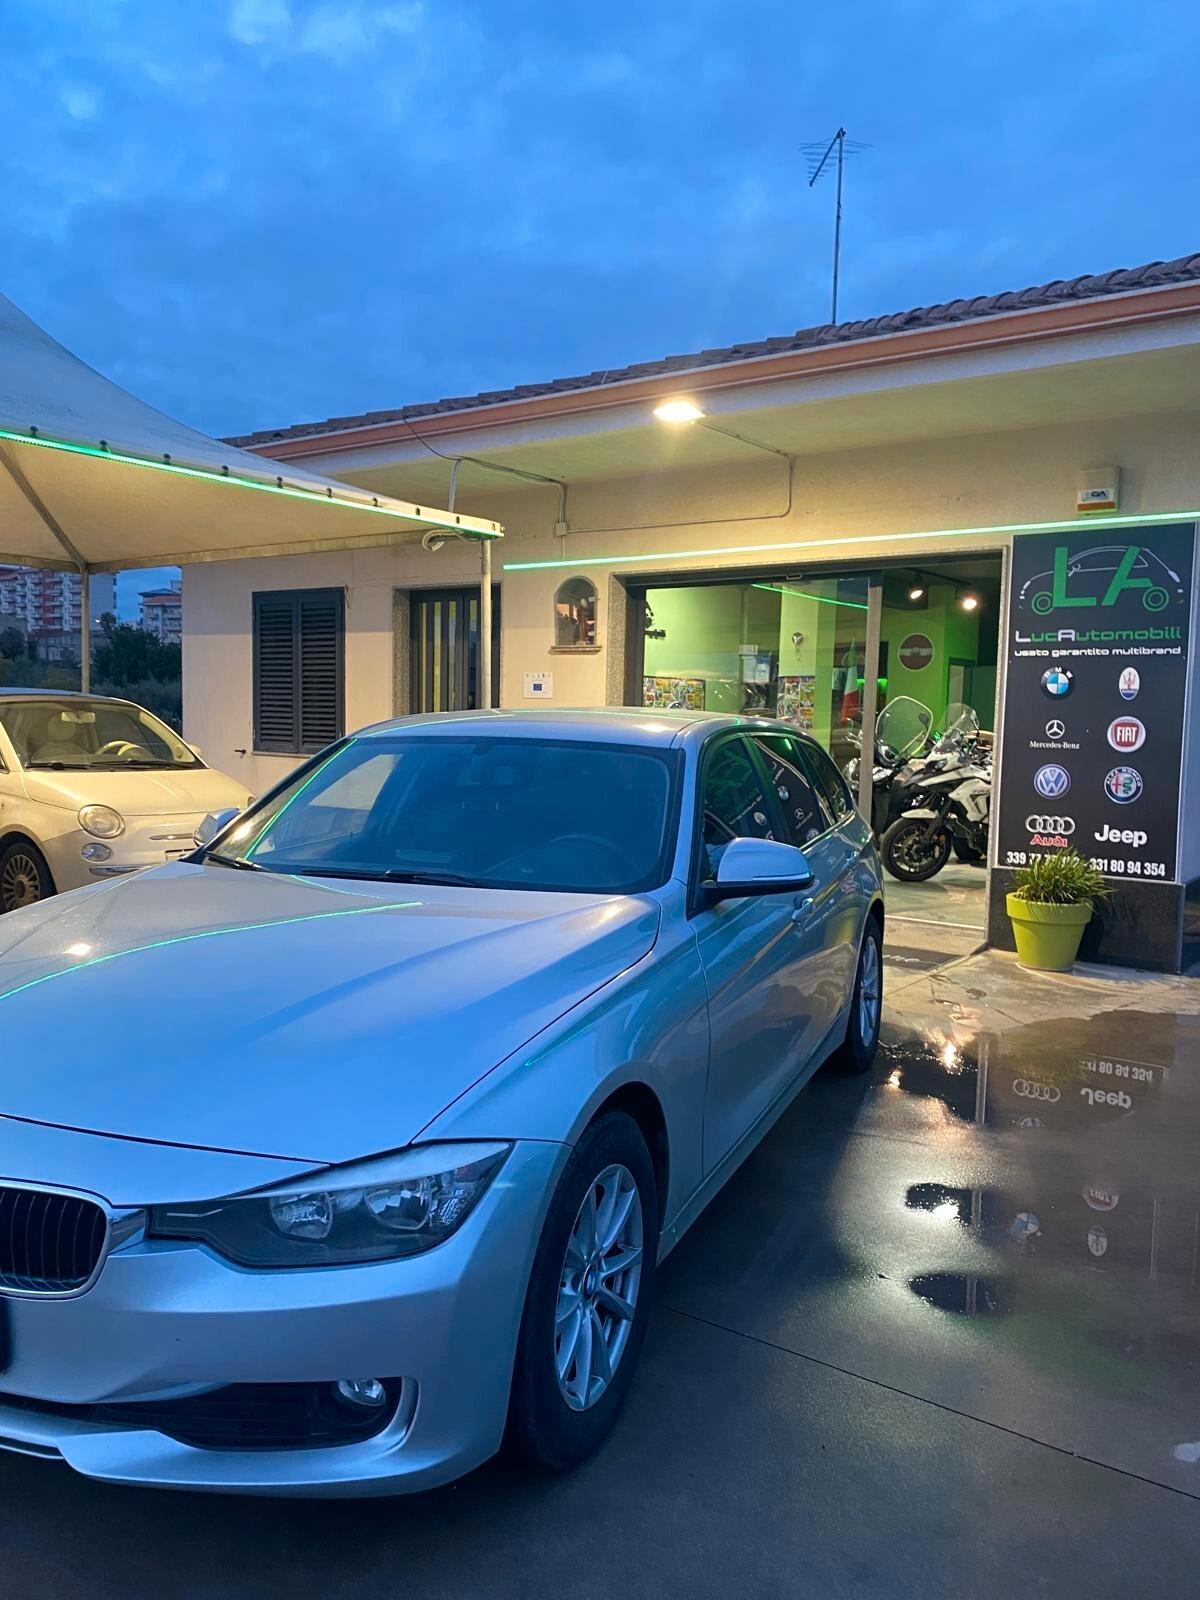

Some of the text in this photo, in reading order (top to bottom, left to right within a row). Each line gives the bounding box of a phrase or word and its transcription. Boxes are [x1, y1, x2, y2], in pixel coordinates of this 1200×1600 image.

[1015, 626, 1182, 643] LucAutomobili
[1014, 646, 1182, 658] usato garantito multibrand
[1116, 726, 1138, 743] FIAT
[1029, 741, 1080, 750] Mercedes-Benz
[1029, 834, 1068, 848] Audi
[1094, 824, 1148, 848] Jeep
[1006, 851, 1026, 865] 339
[1089, 858, 1107, 872] 331
[1110, 859, 1125, 873] 80
[1127, 861, 1141, 875] 94
[1143, 863, 1166, 877] 354
